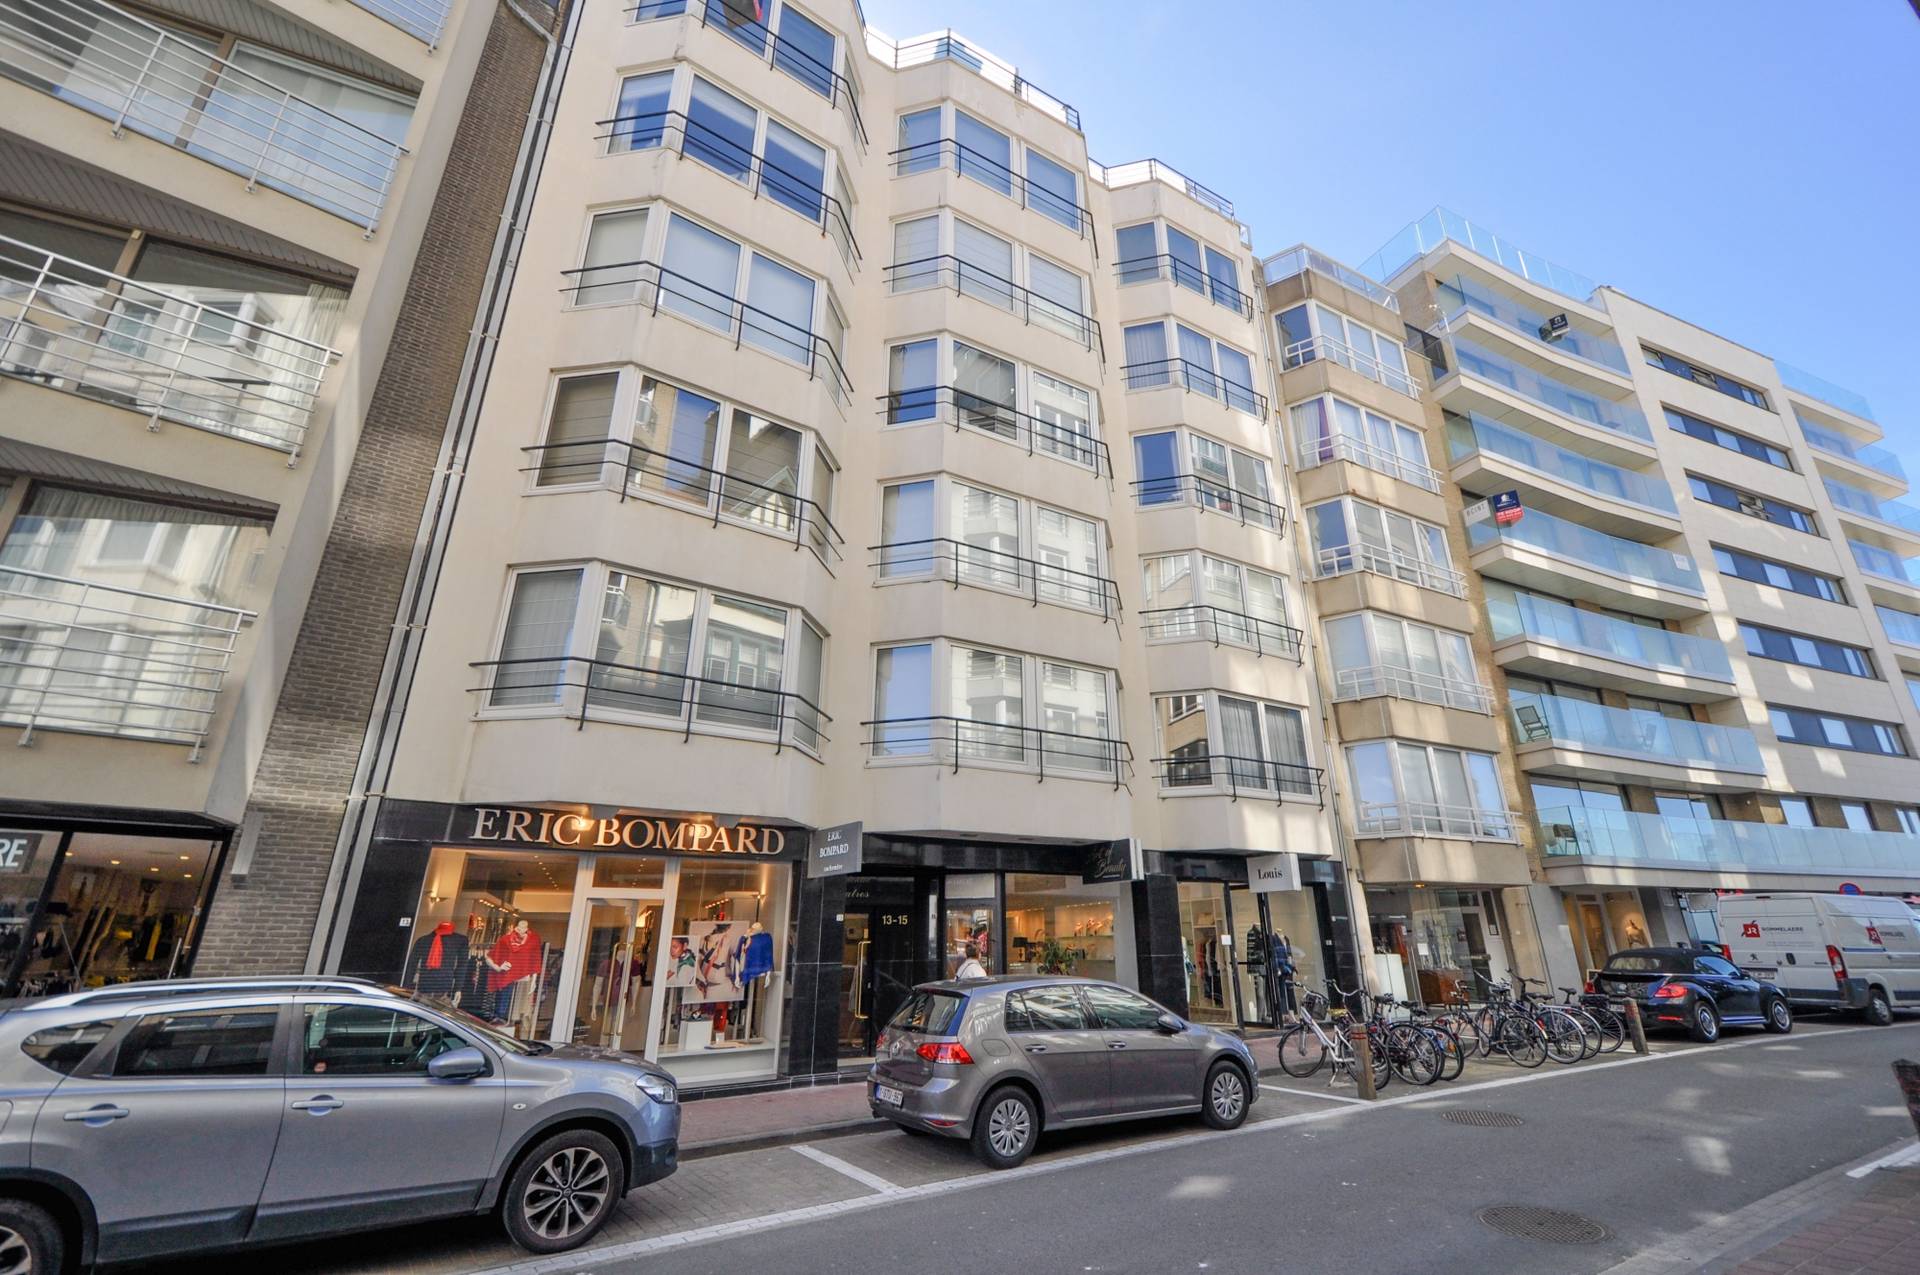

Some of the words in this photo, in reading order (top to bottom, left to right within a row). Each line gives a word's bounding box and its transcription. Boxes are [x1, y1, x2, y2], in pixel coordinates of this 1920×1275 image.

[469, 808, 583, 845] ERIC
[593, 818, 785, 854] BOMPARD
[827, 831, 842, 841] ERIC
[819, 843, 849, 858] BOMPARD
[1094, 857, 1127, 880] Beauty
[1258, 867, 1283, 880] Louis
[882, 914, 908, 926] 13-15
[1746, 927, 1758, 935] JR
